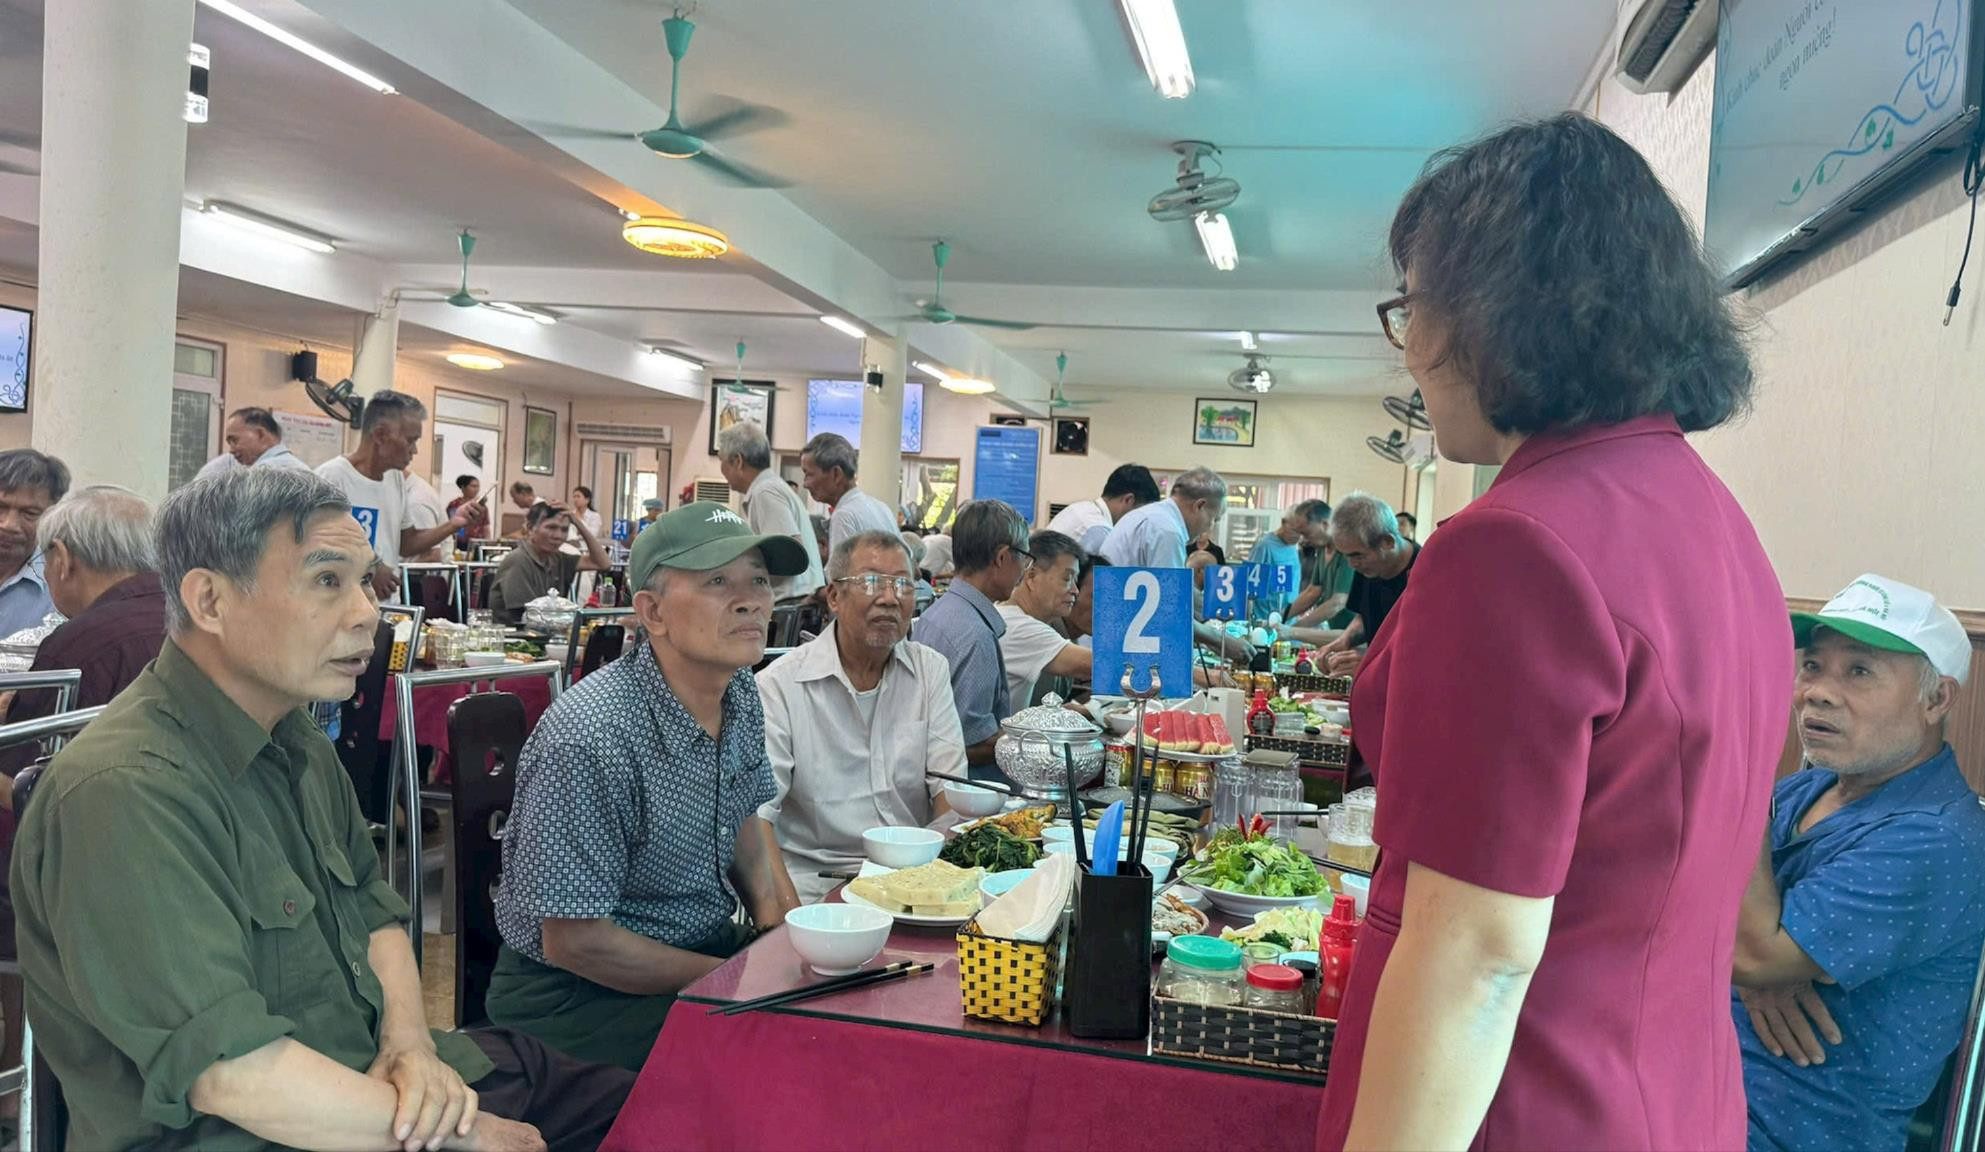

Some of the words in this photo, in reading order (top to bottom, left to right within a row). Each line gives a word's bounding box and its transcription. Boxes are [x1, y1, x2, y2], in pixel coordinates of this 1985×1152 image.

[613, 520, 628, 535] 21
[1216, 566, 1235, 602] 3
[1248, 563, 1261, 587] 4
[1276, 565, 1287, 585] 5
[1123, 570, 1161, 654] 2
